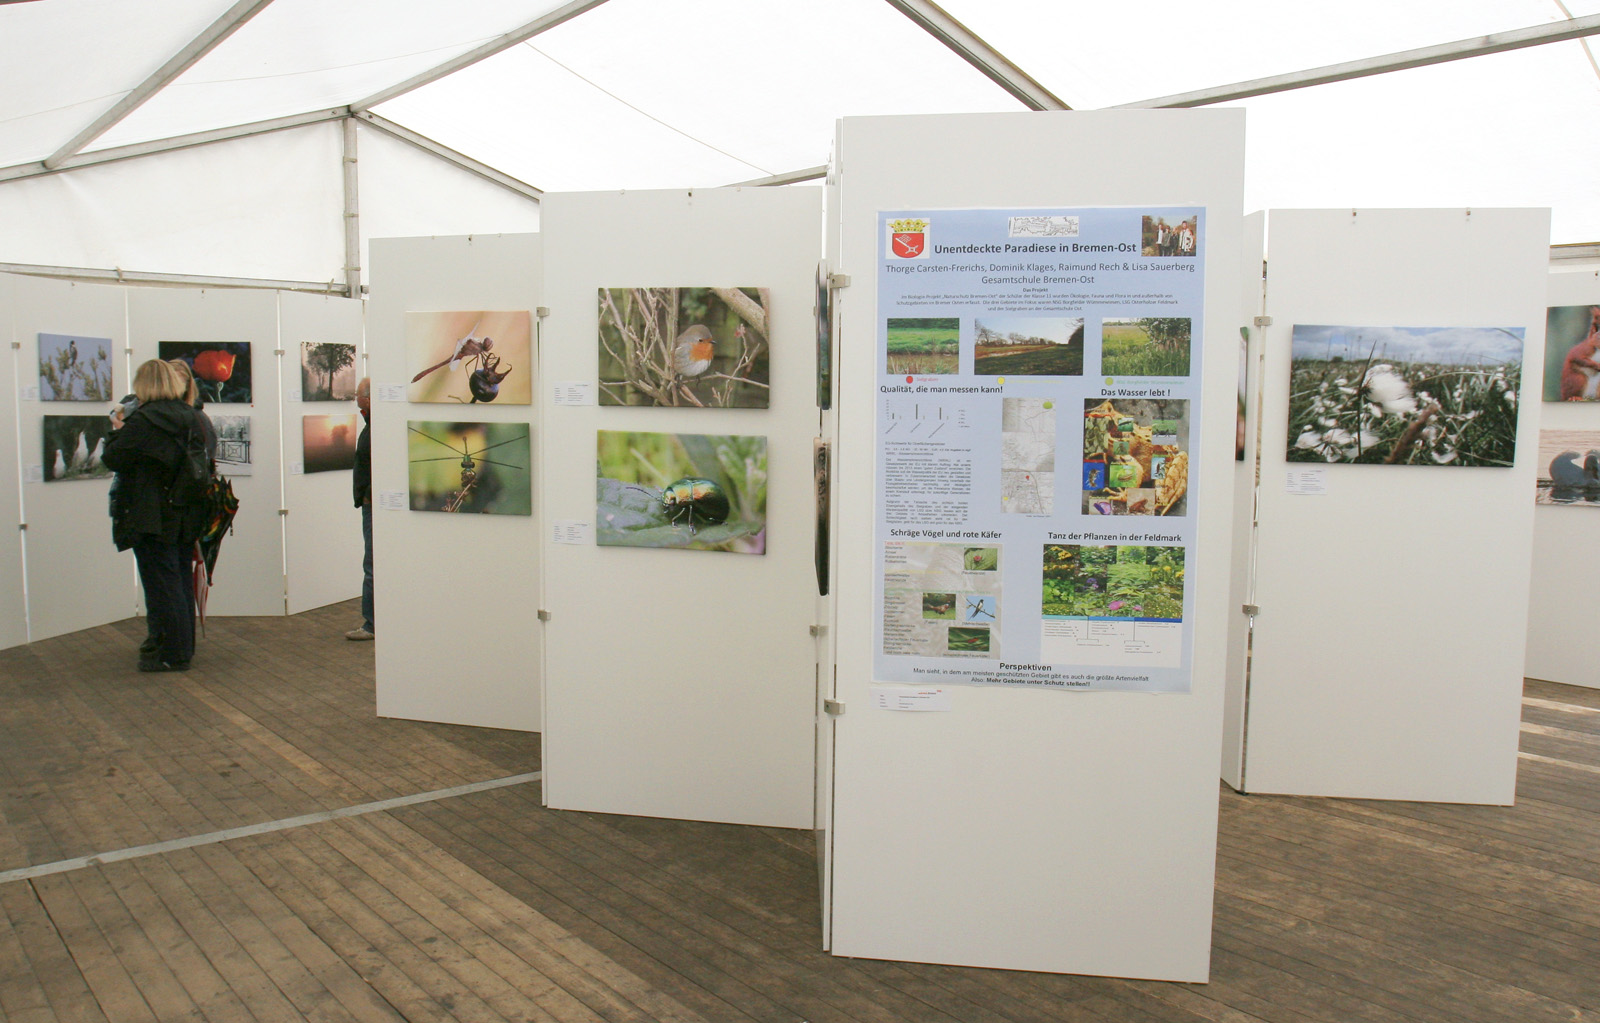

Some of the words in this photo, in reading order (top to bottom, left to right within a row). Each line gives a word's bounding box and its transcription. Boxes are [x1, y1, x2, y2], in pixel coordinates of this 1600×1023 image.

[934, 244, 1001, 254] Unentdeckte
[1005, 244, 1056, 253] Paradiese
[1060, 243, 1069, 252] in
[1073, 242, 1136, 252] Bremen-Ost
[886, 265, 914, 274] Thorge
[917, 264, 987, 273] Carsten-Frerichs,
[990, 264, 1024, 272] Dominik
[1027, 263, 1056, 272] Klages,
[1059, 263, 1096, 271] Raimund
[1150, 262, 1195, 272] Sauerberg
[982, 276, 1041, 284] Gesamtschule
[880, 385, 914, 393] Qualität,
[890, 529, 920, 537] Schräge
[923, 530, 944, 538] Vögel
[999, 663, 1052, 671] Perspektiven
